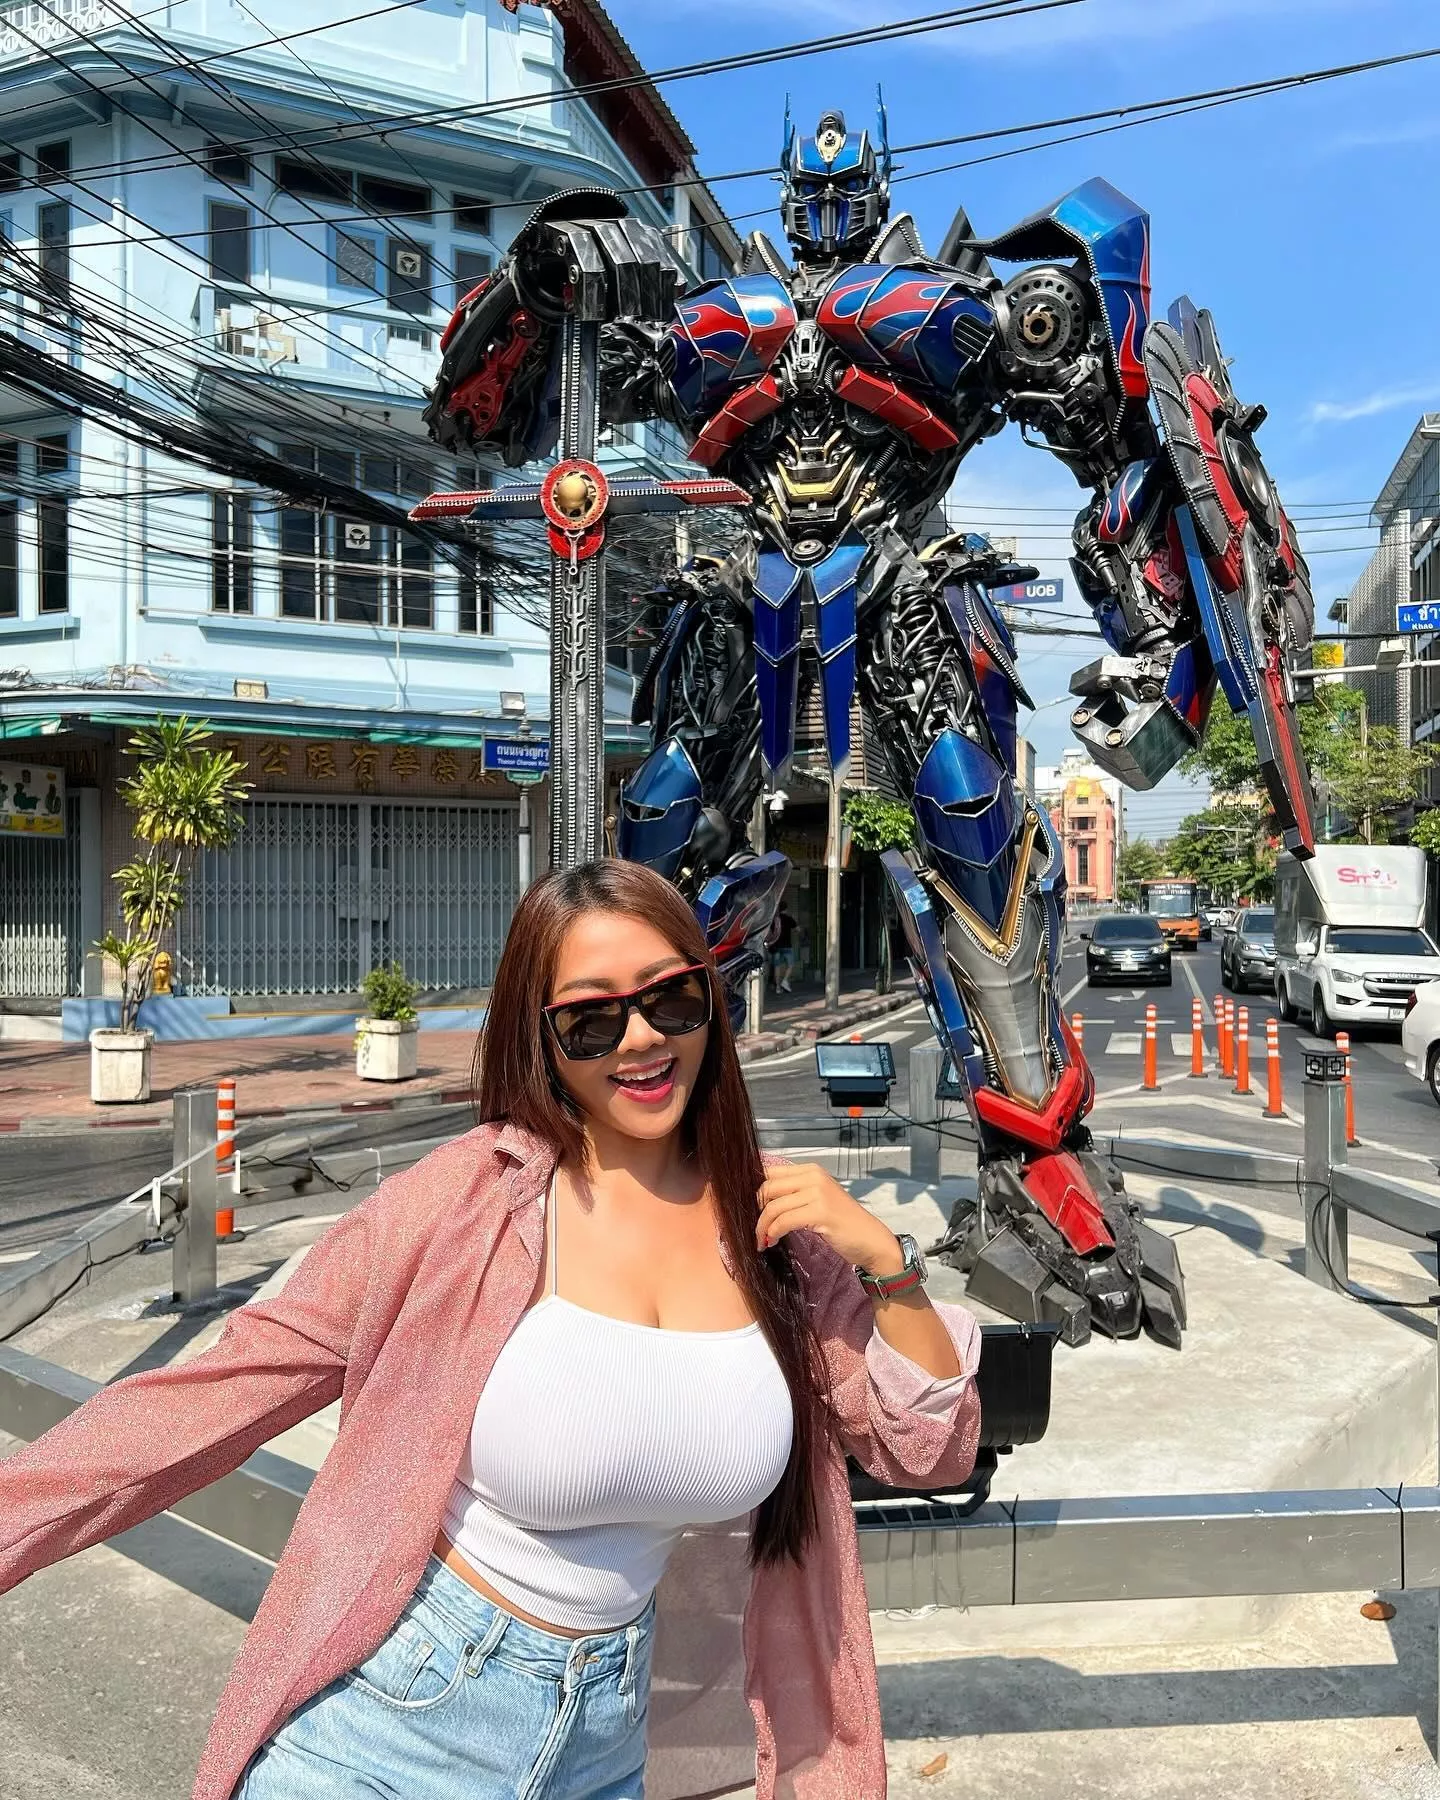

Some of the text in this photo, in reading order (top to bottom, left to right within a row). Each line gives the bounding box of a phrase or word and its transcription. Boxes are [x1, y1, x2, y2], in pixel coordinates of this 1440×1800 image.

[1026, 584, 1057, 598] UOB
[496, 744, 549, 761] ถนนเจริญกรุ
